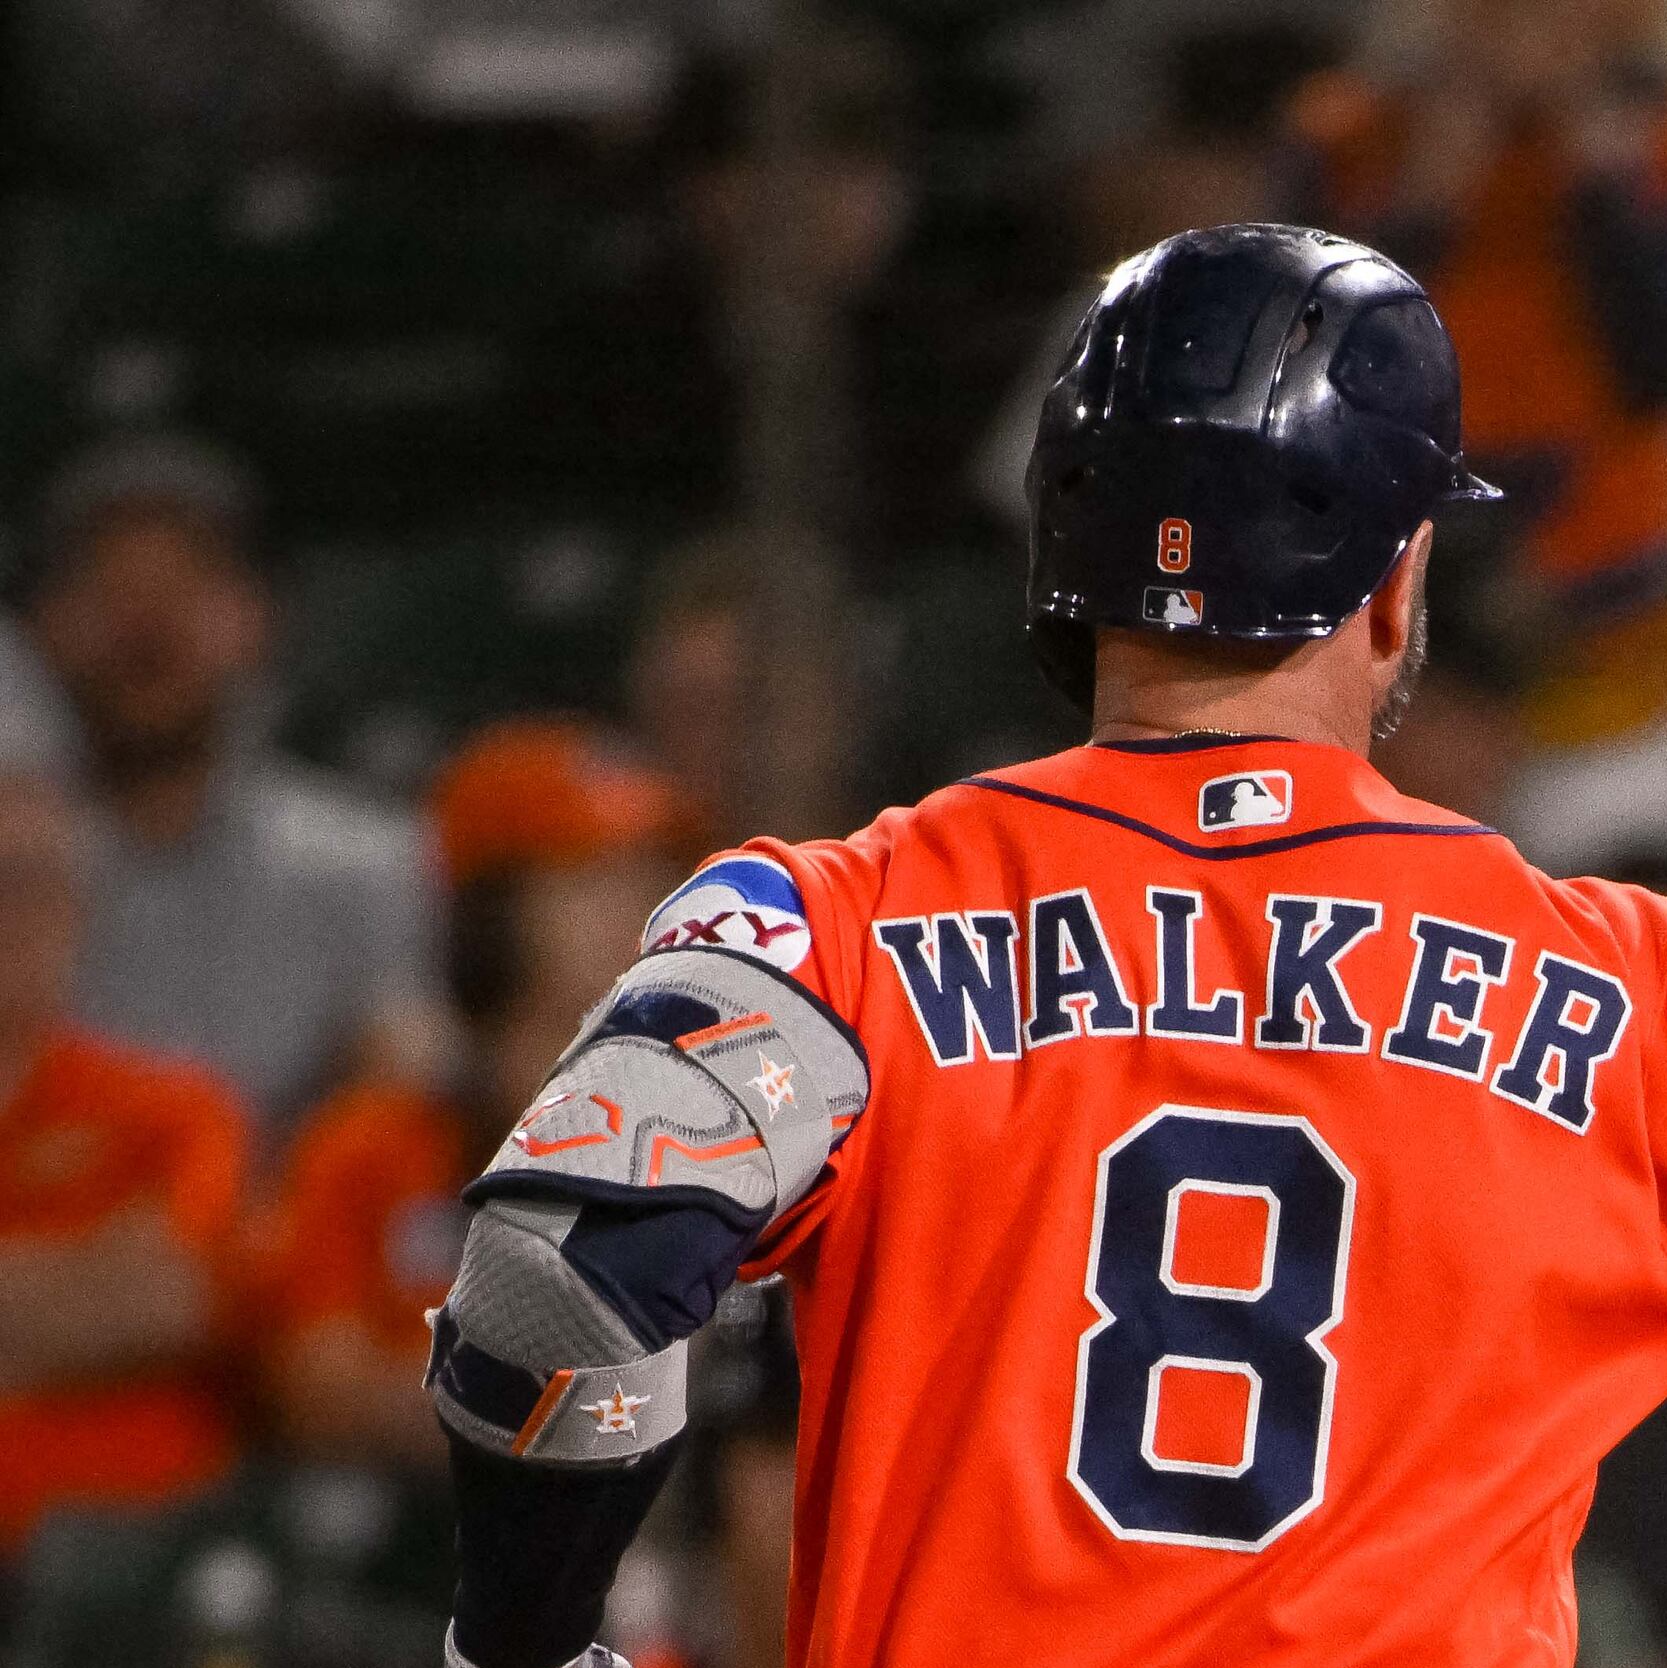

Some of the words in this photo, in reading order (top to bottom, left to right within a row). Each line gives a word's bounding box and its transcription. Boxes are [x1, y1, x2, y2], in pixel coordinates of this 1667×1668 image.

[1157, 517, 1192, 573] 8
[873, 888, 1632, 1135] WALKER
[1065, 1103, 1357, 1552] 8
